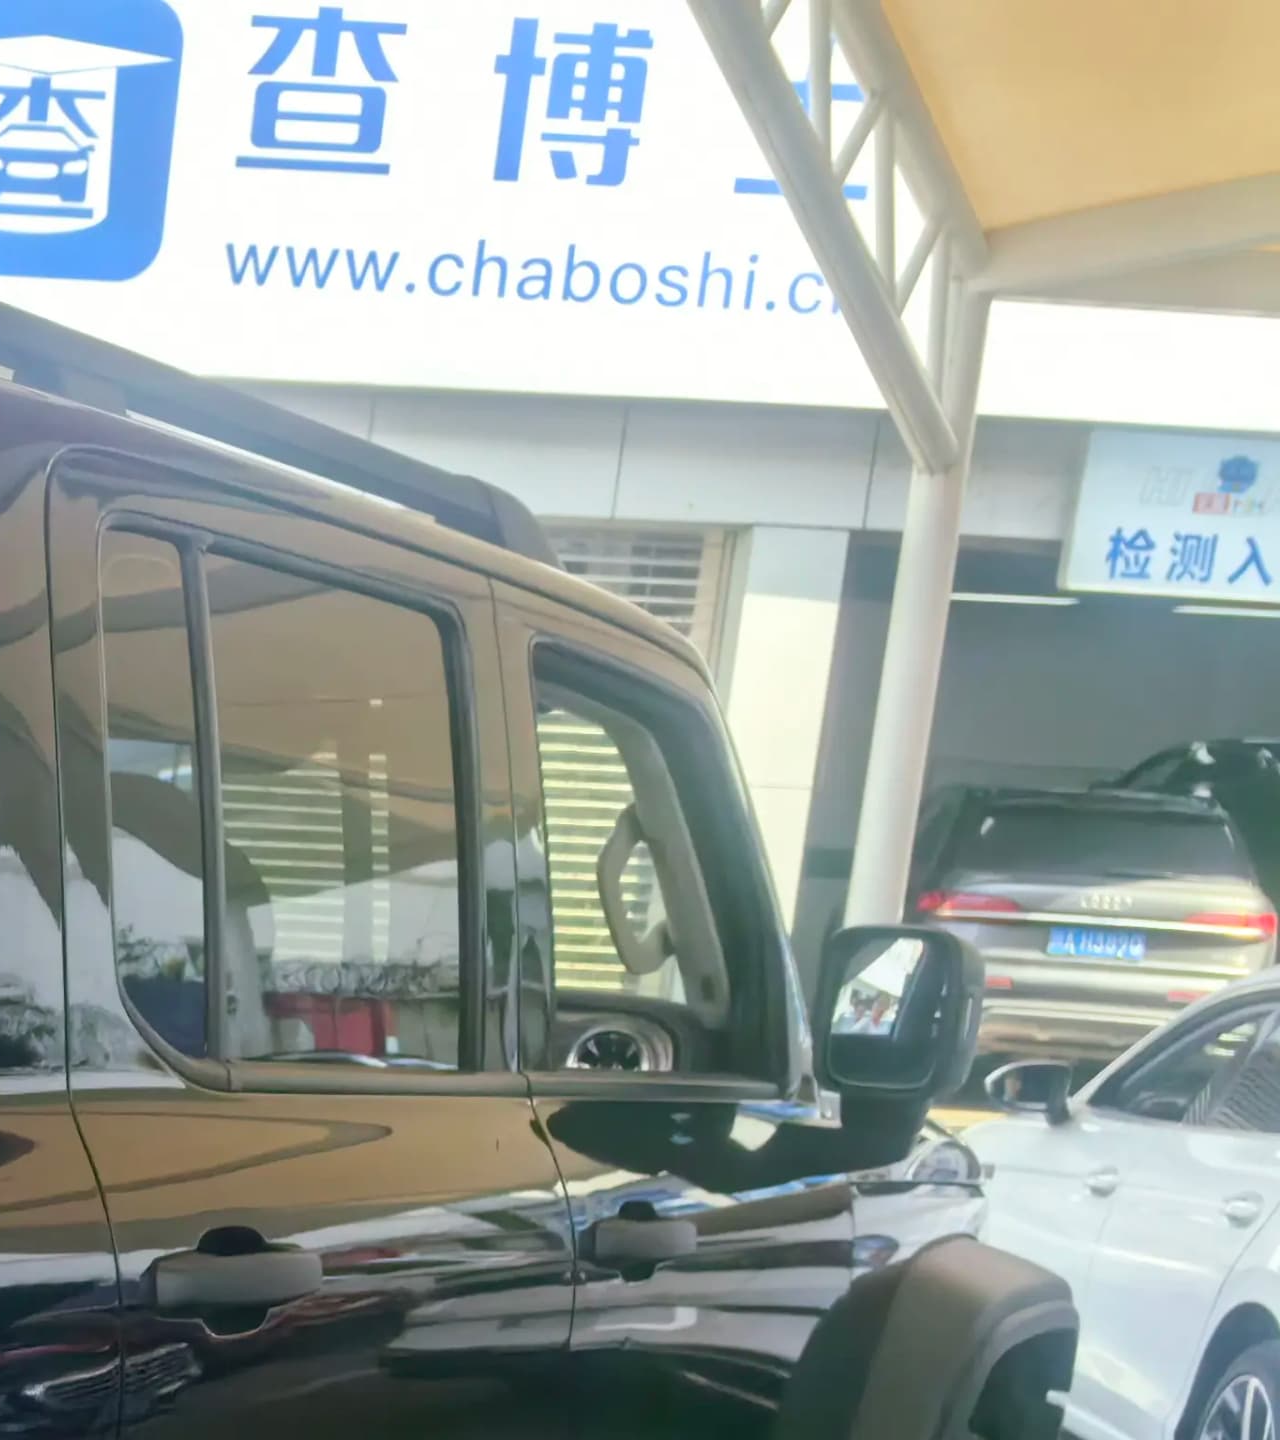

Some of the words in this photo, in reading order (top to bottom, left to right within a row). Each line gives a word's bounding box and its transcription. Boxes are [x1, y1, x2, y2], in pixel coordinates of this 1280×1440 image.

[225, 240, 841, 315] www.chaboshi.c
[1105, 527, 1274, 586] 检测入
